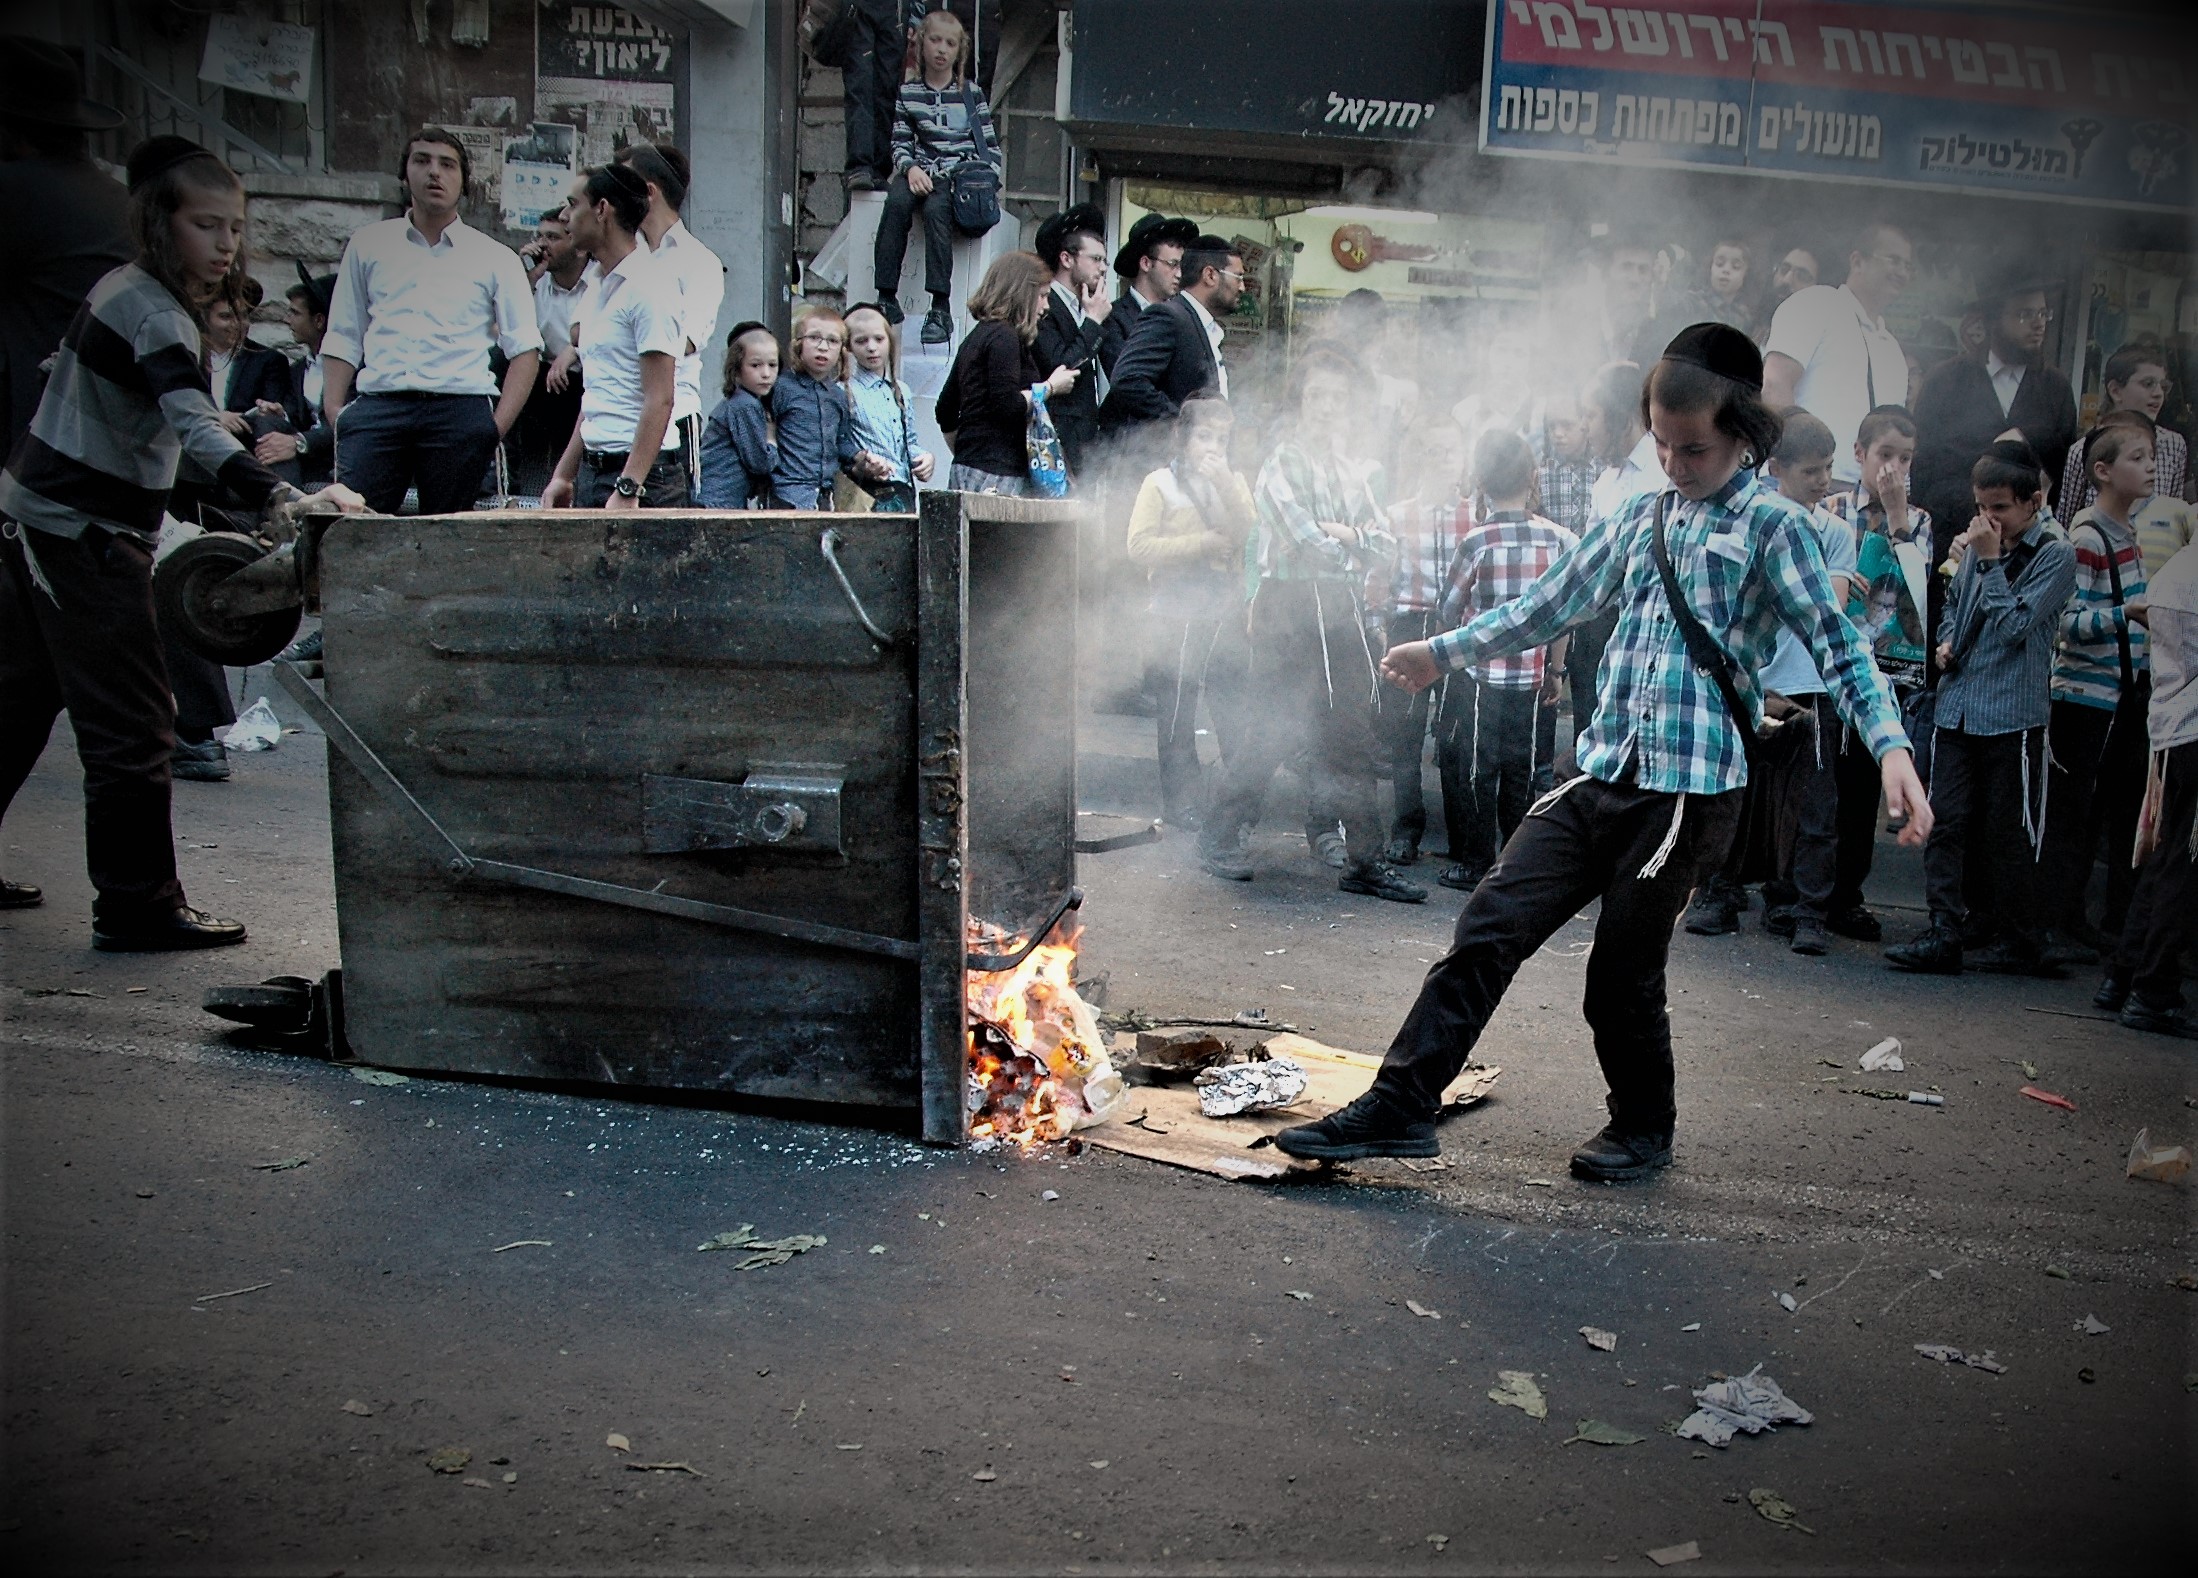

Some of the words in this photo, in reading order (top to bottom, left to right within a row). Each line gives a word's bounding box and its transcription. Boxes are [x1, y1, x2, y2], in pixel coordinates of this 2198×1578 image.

[576, 38, 671, 76] ליאון?
[1507, 0, 1796, 67] הירושלמי
[1819, 26, 2067, 93] הבטיחות
[2091, 52, 2189, 103] בית
[1324, 91, 1435, 132] יחזקאל
[1497, 84, 1599, 135] כספות
[1612, 94, 1741, 146] מפתחות
[1758, 102, 1883, 159] מנעולים
